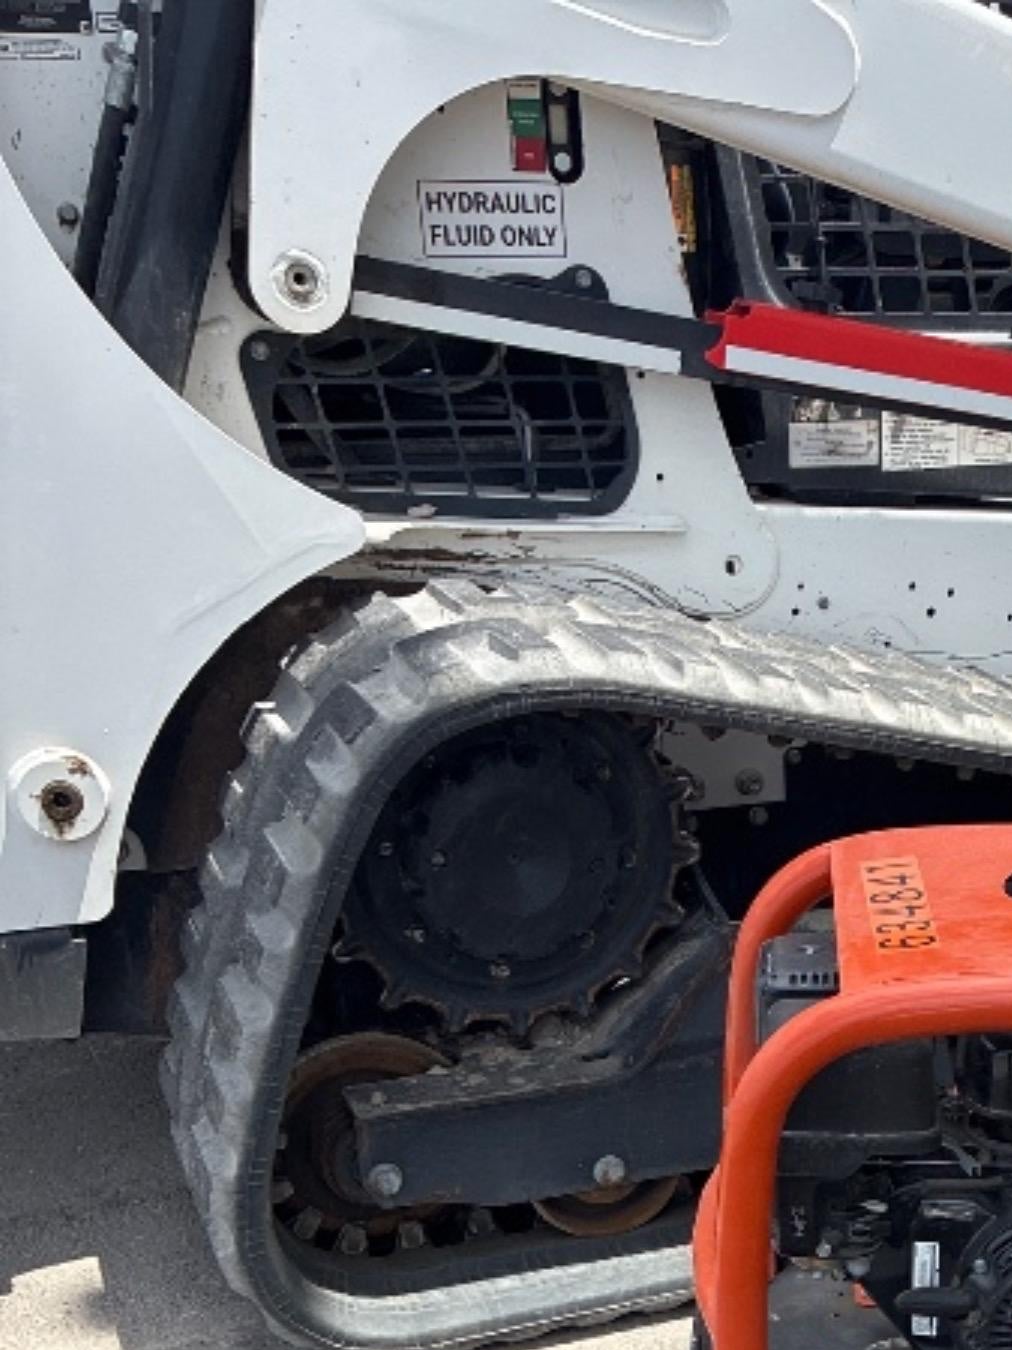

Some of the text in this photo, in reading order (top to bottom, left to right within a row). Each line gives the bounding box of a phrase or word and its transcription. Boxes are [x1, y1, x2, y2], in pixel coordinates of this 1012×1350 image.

[425, 191, 556, 214] HYDRAULIC
[430, 224, 557, 247] FLUID ONLY
[863, 862, 936, 950] 634841
